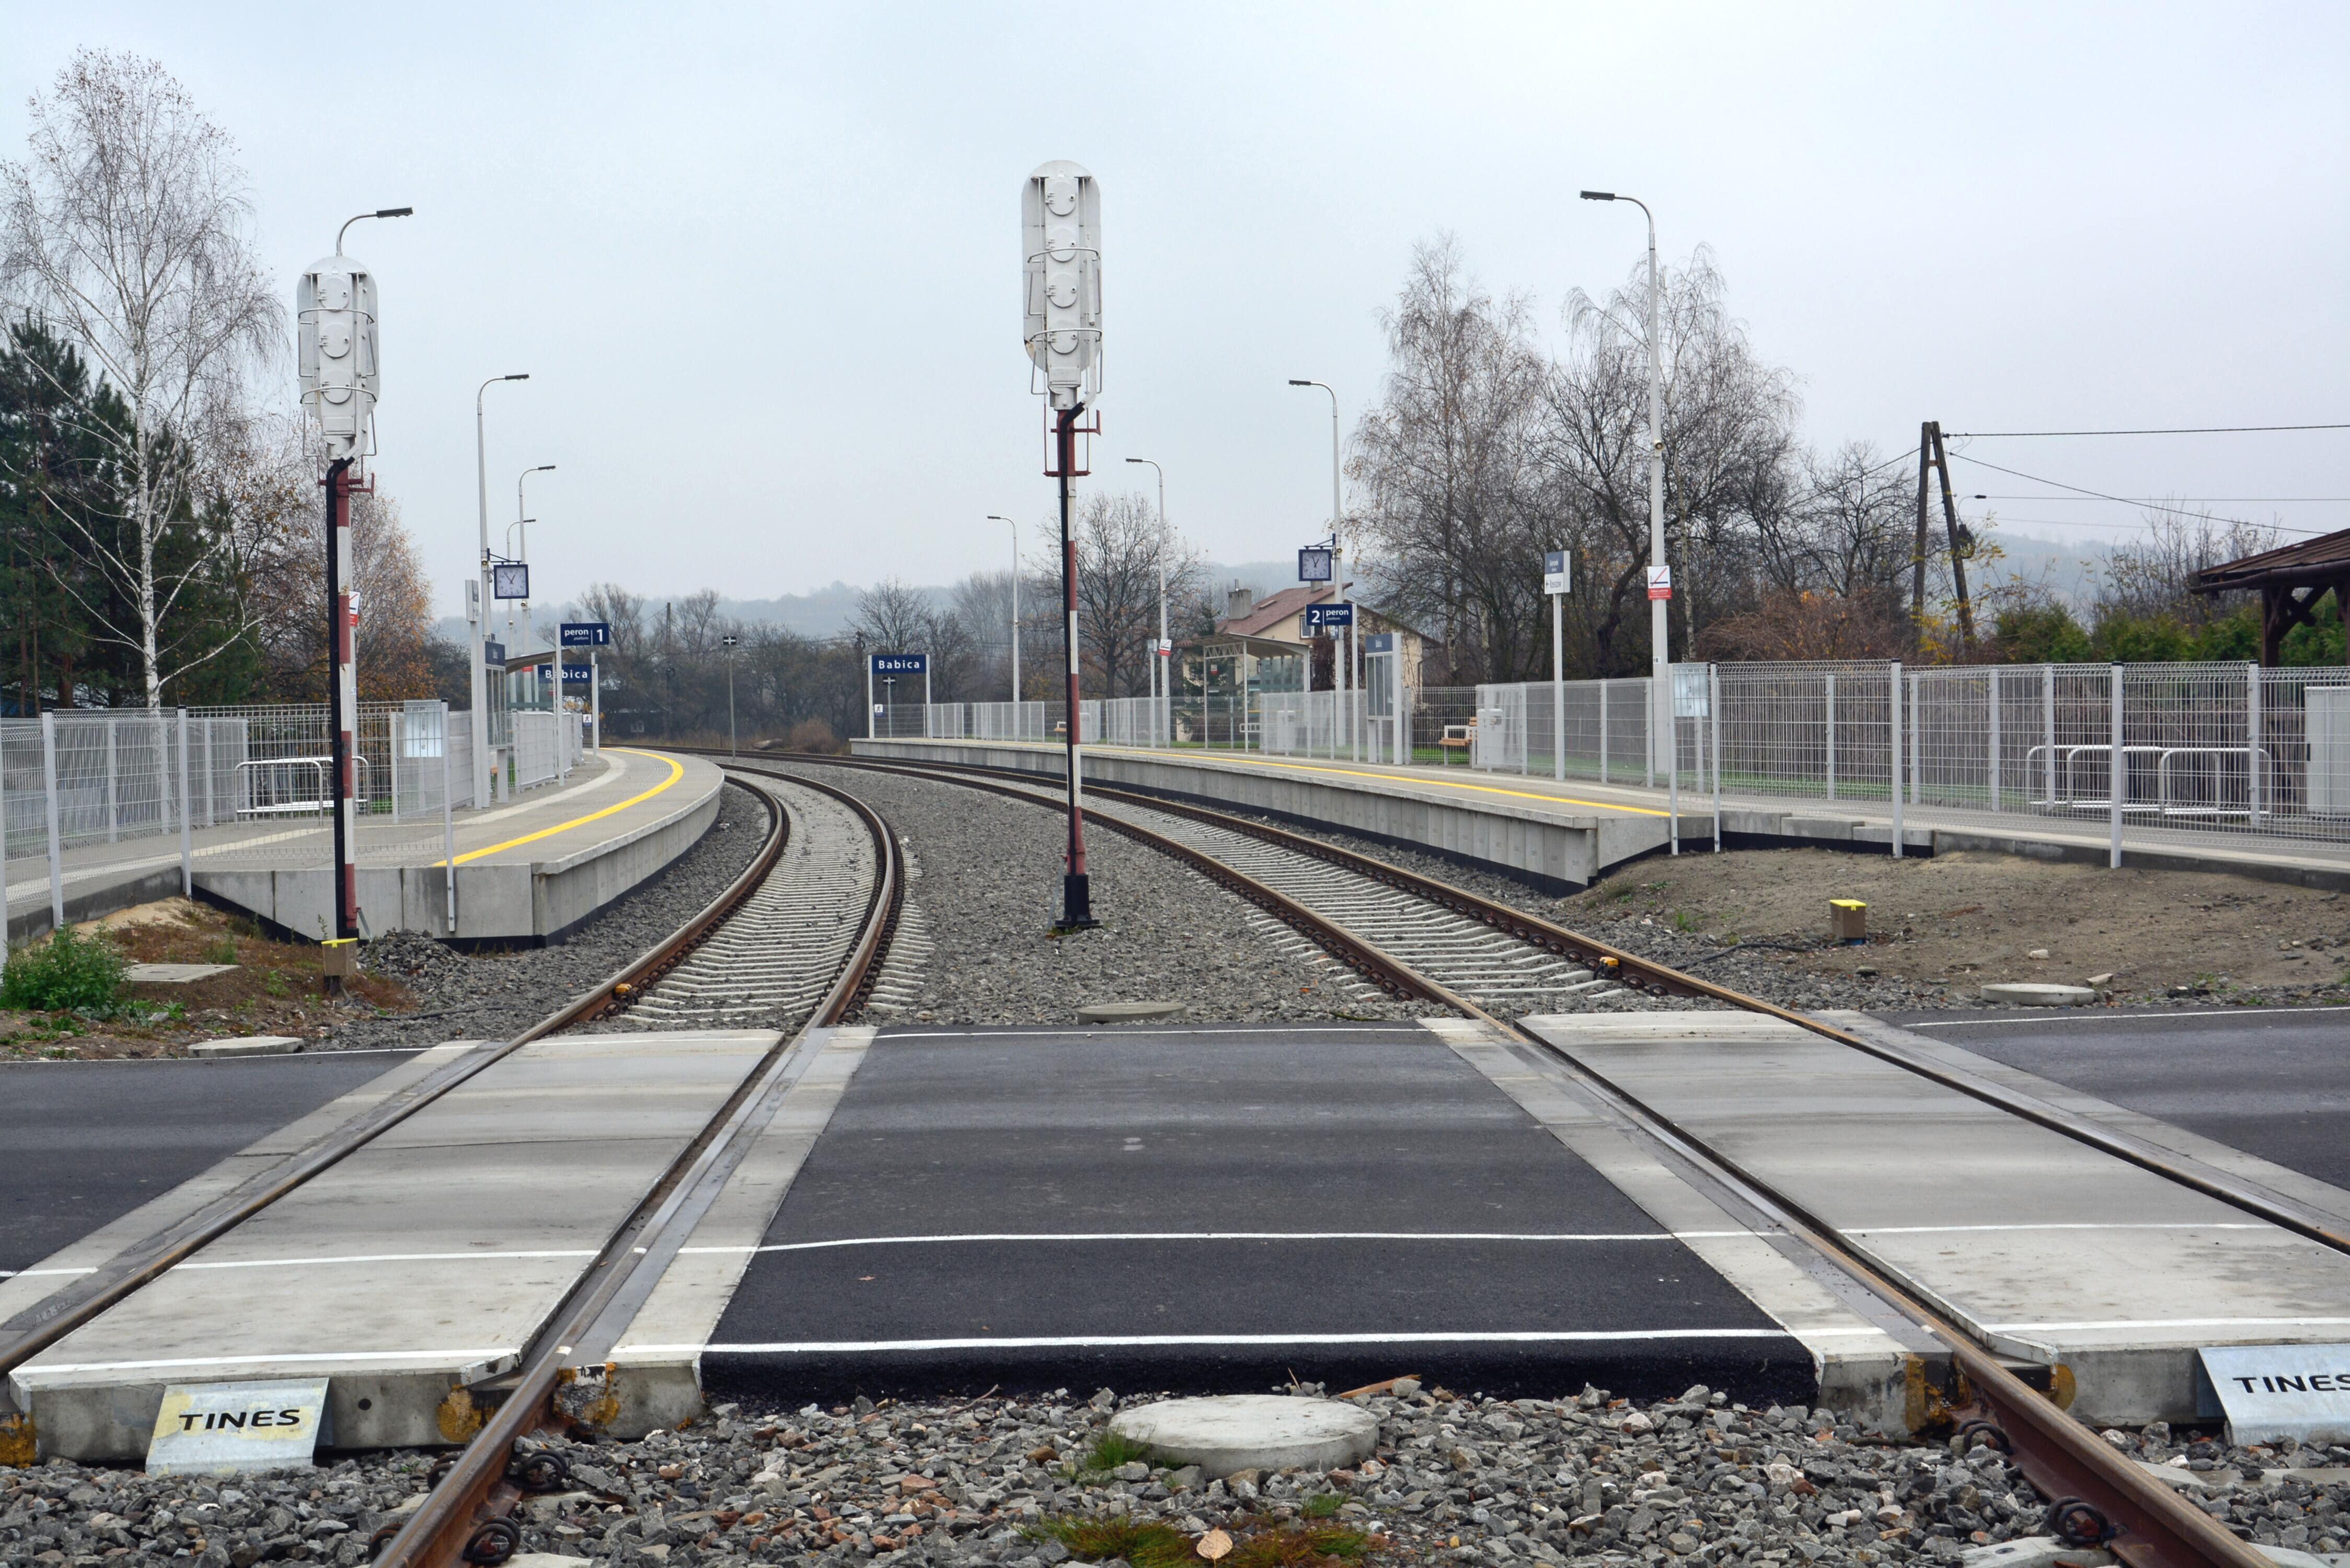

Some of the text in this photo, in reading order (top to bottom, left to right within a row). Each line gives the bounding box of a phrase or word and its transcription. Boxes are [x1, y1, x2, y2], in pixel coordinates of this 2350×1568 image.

[1311, 610, 1320, 623] 2
[565, 629, 589, 637] peron
[596, 629, 603, 642] 1
[879, 660, 920, 669] Babica
[545, 670, 588, 678] Bbica
[179, 1409, 300, 1431] TINES
